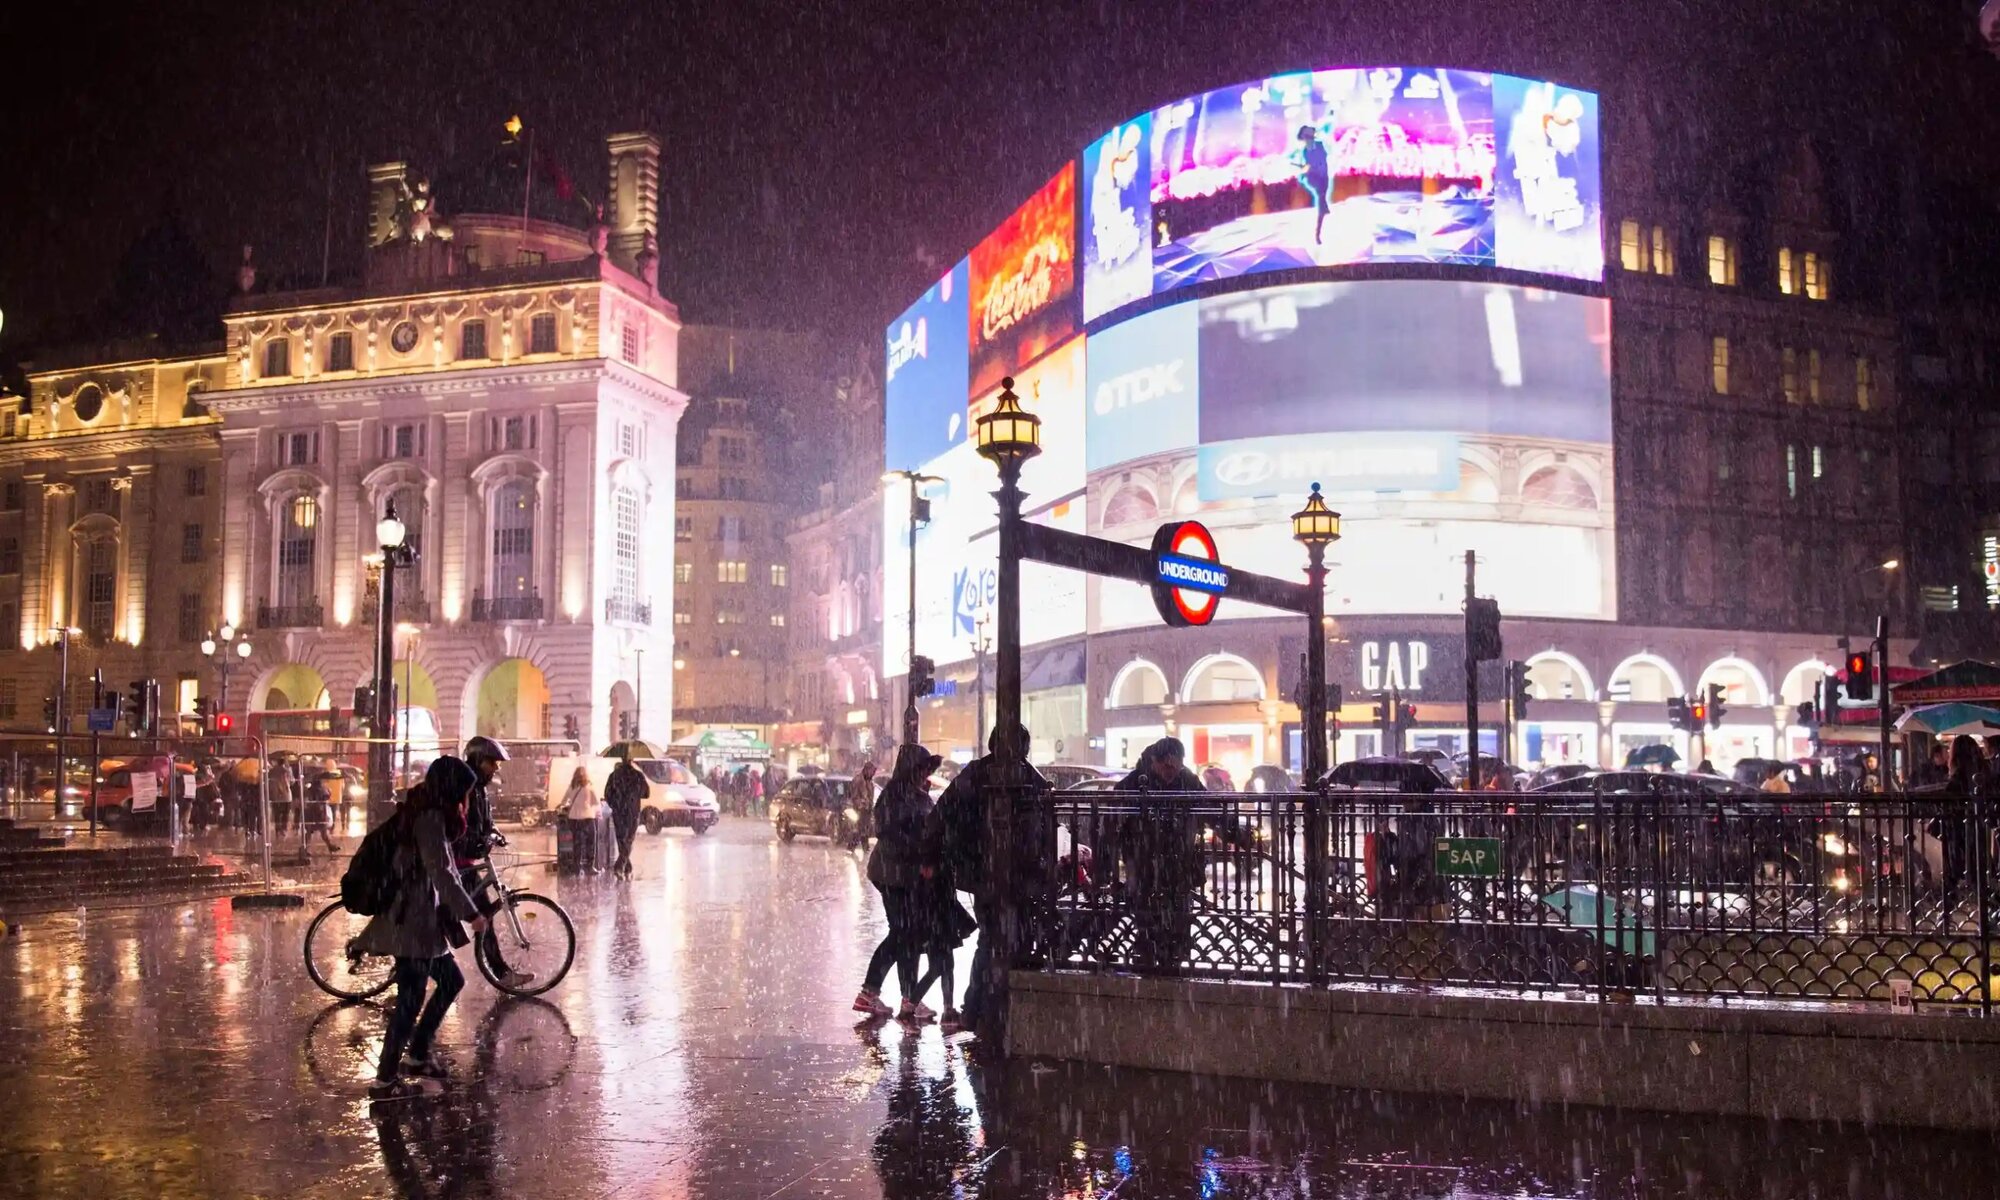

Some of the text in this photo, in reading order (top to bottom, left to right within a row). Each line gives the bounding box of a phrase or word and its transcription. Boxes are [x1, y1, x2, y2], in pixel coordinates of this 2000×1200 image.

[1111, 358, 1184, 409] TDK
[1159, 560, 1229, 587] UNDERGROUND
[1362, 641, 1427, 690] GAP
[1450, 849, 1486, 864] SAP
